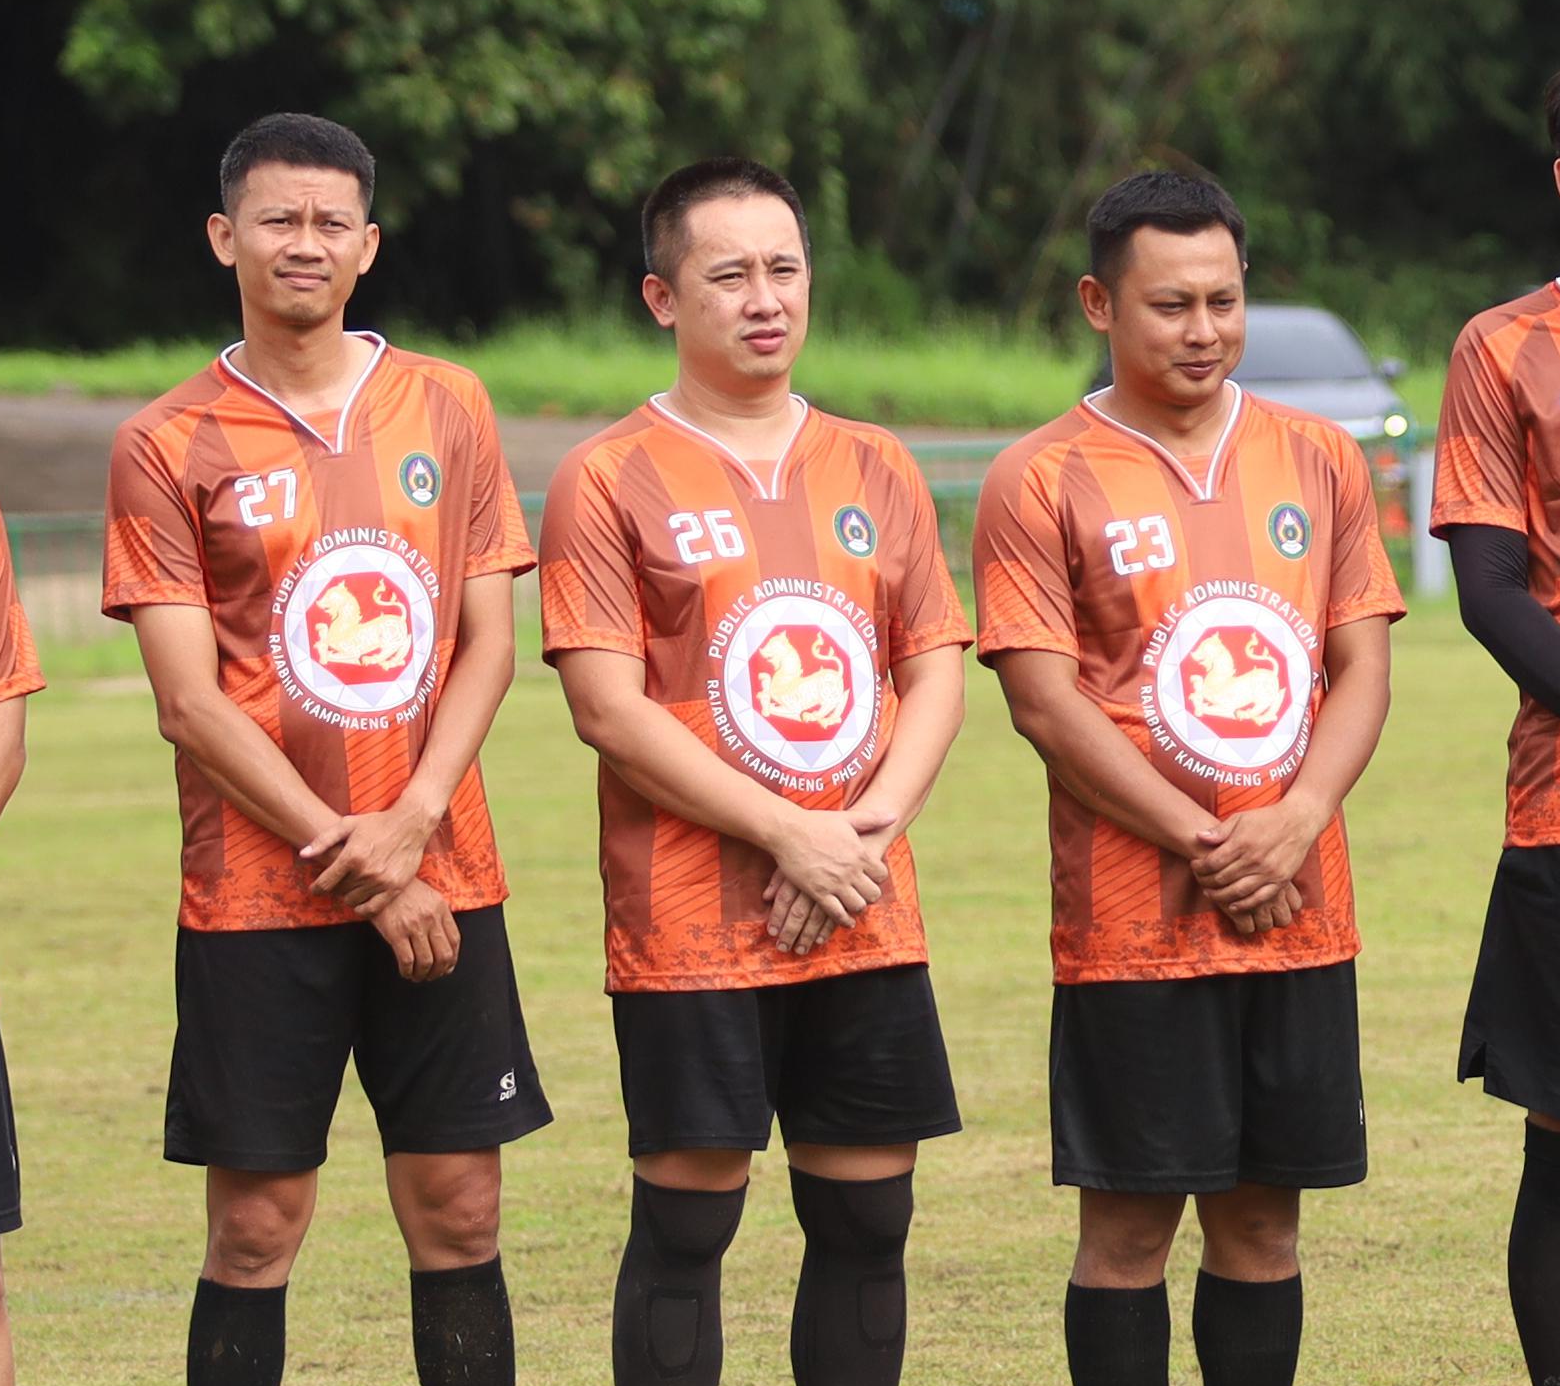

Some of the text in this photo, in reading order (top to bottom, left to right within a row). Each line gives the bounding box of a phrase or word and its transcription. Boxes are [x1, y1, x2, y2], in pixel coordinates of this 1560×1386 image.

[233, 468, 297, 528] 27
[668, 509, 745, 565] 26
[1105, 515, 1175, 576] 23
[272, 526, 440, 615] PUBLIC ADMINISTRATION
[708, 577, 878, 660] PUBLIC ADMINISTRATION
[1143, 579, 1319, 667] PUBLIC ADMINISTRATION
[301, 697, 389, 730] KAMPHAENG
[740, 749, 824, 792] KAMPHAENG
[831, 757, 864, 786] PHET
[1174, 750, 1263, 787] KAMPHAENG
[1269, 755, 1298, 781] PHET
